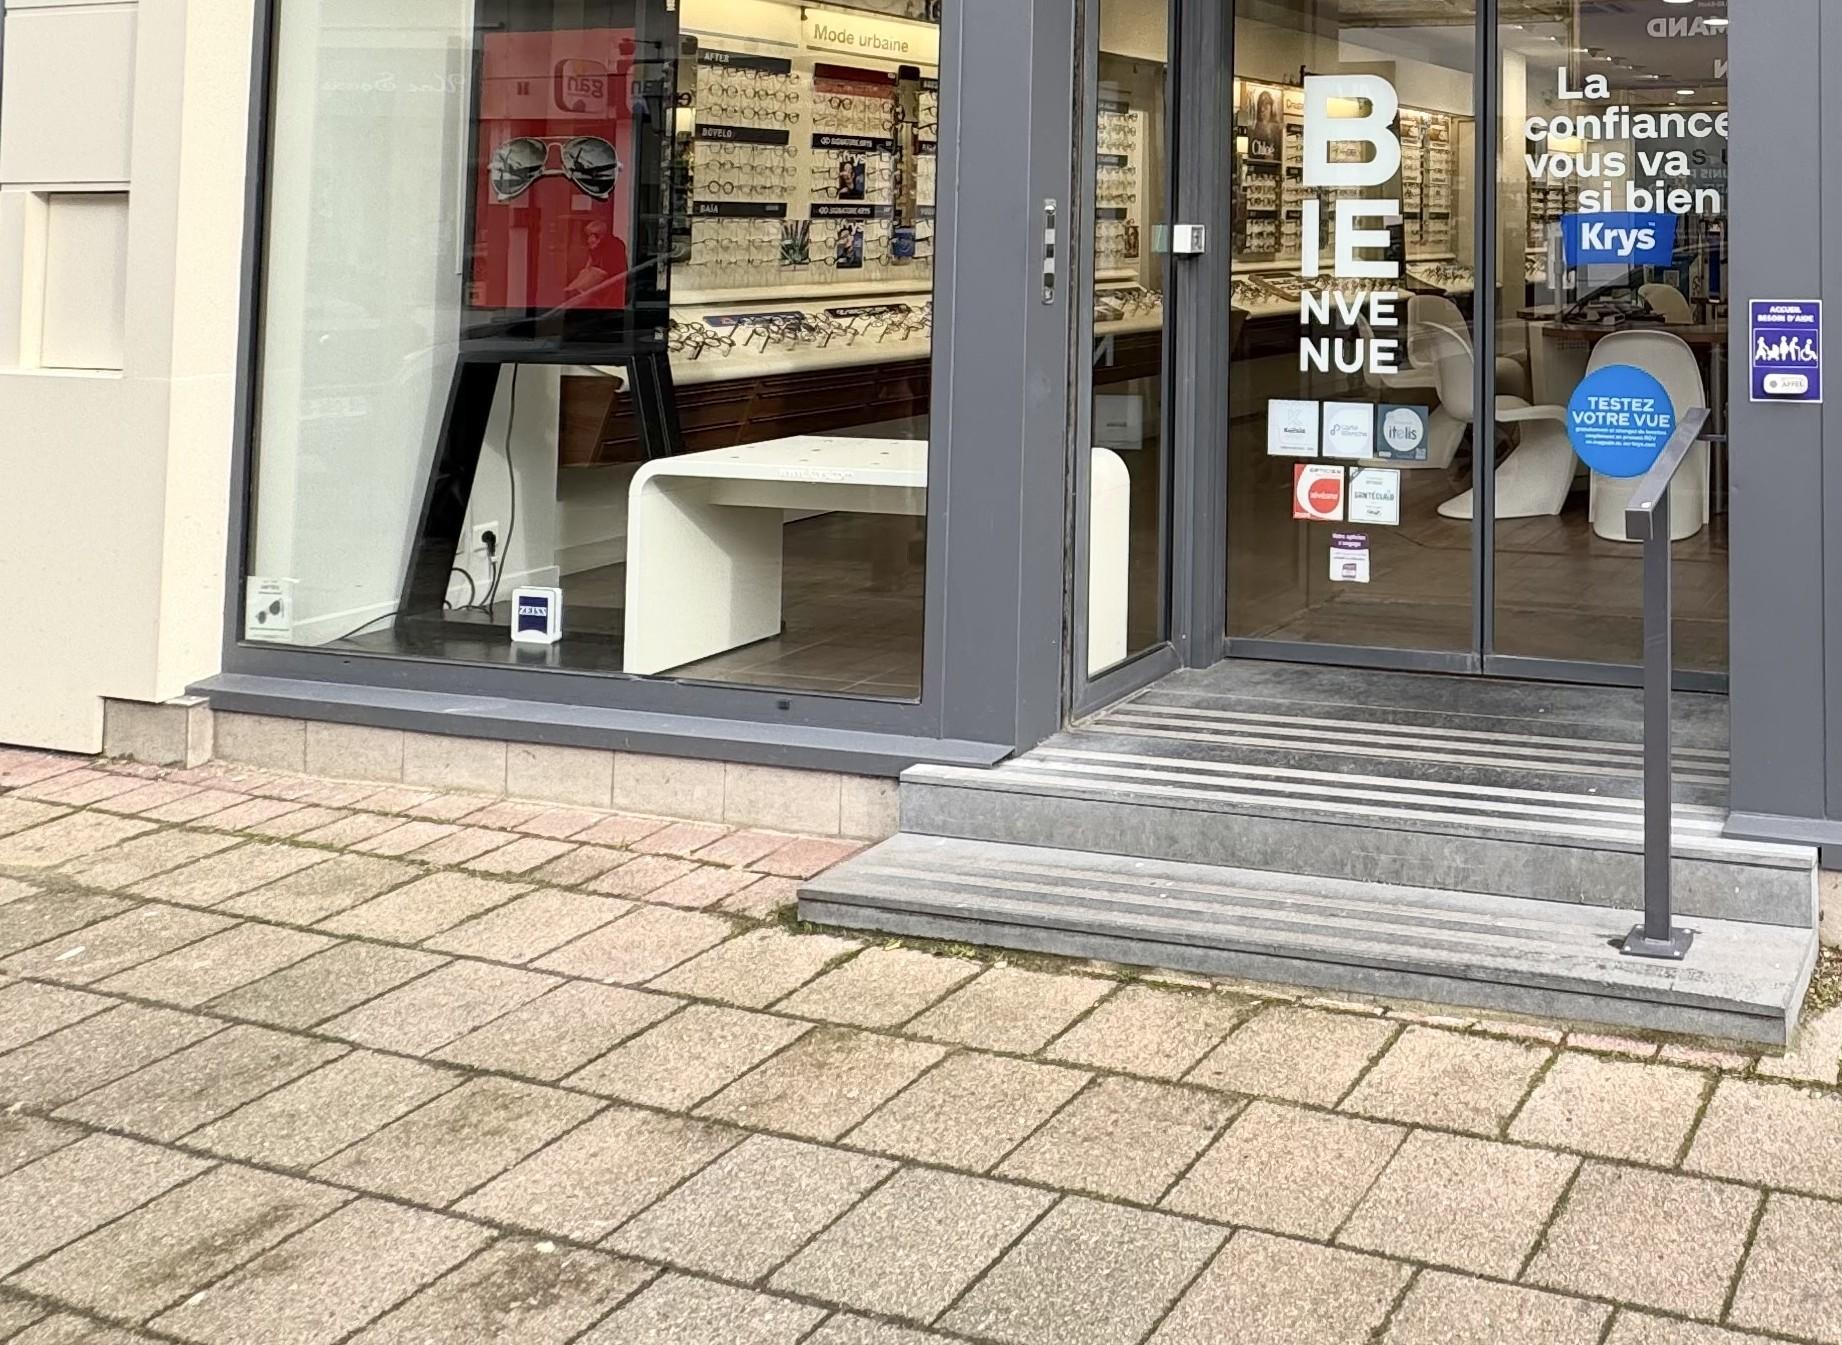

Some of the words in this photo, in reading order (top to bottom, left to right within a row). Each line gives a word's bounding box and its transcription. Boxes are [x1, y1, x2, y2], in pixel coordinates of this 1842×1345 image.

[814, 24, 854, 44] Mode
[859, 33, 908, 53] urbaine
[1558, 67, 1610, 100] La
[1525, 149, 1625, 179] vous
[1638, 149, 1690, 178] va
[1578, 182, 1612, 214] si
[1626, 180, 1721, 214] bien
[1581, 223, 1656, 256] Krys
[1301, 291, 1398, 326] NVE
[1301, 339, 1398, 374] NUE
[1573, 411, 1630, 425] VOTRE
[1634, 413, 1670, 427] VUE
[1588, 397, 1654, 411] TESTEZ
[1389, 427, 1417, 440] itelis
[519, 605, 547, 616] ZEISS
